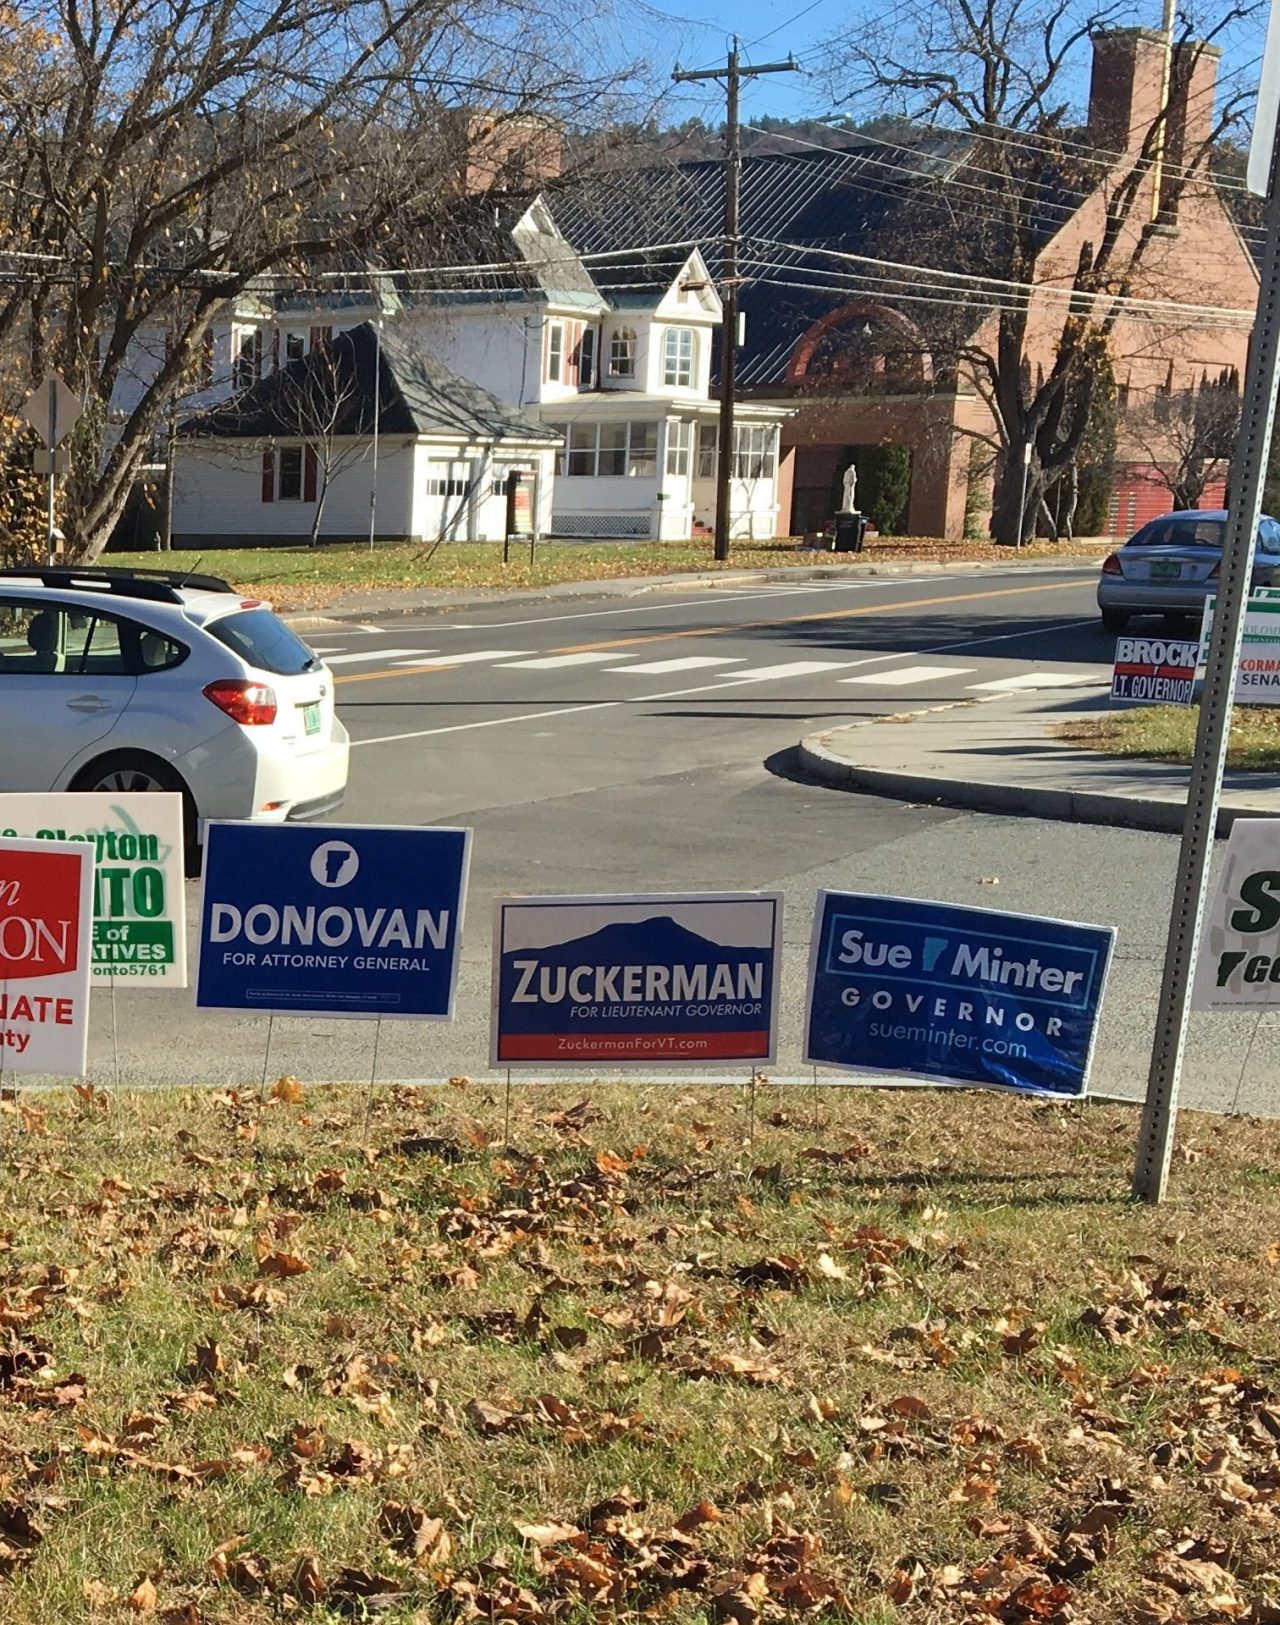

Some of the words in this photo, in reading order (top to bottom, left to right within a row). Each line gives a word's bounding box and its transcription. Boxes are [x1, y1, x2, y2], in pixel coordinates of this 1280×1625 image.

[1118, 640, 1199, 668] BROCK
[1113, 675, 1128, 697] LT.
[1131, 676, 1192, 704] GOVERNOR
[106, 925, 129, 941] of
[209, 903, 450, 950] DONOVAN
[223, 953, 256, 966] FOR
[261, 953, 349, 969] ATTORNEY
[353, 956, 430, 971] GENERAL
[838, 929, 912, 969] Sue
[950, 943, 1084, 994] Minter
[511, 960, 763, 1003] ZUCKERMAN
[570, 1005, 598, 1018] FOR
[600, 1004, 682, 1018] LIEUTENANT
[685, 1003, 762, 1017] GOVERNOR
[841, 987, 1063, 1037] GOVERNOR
[558, 1037, 708, 1051] ZuckermanForVT.com
[869, 1022, 1027, 1058] sueminter.com
